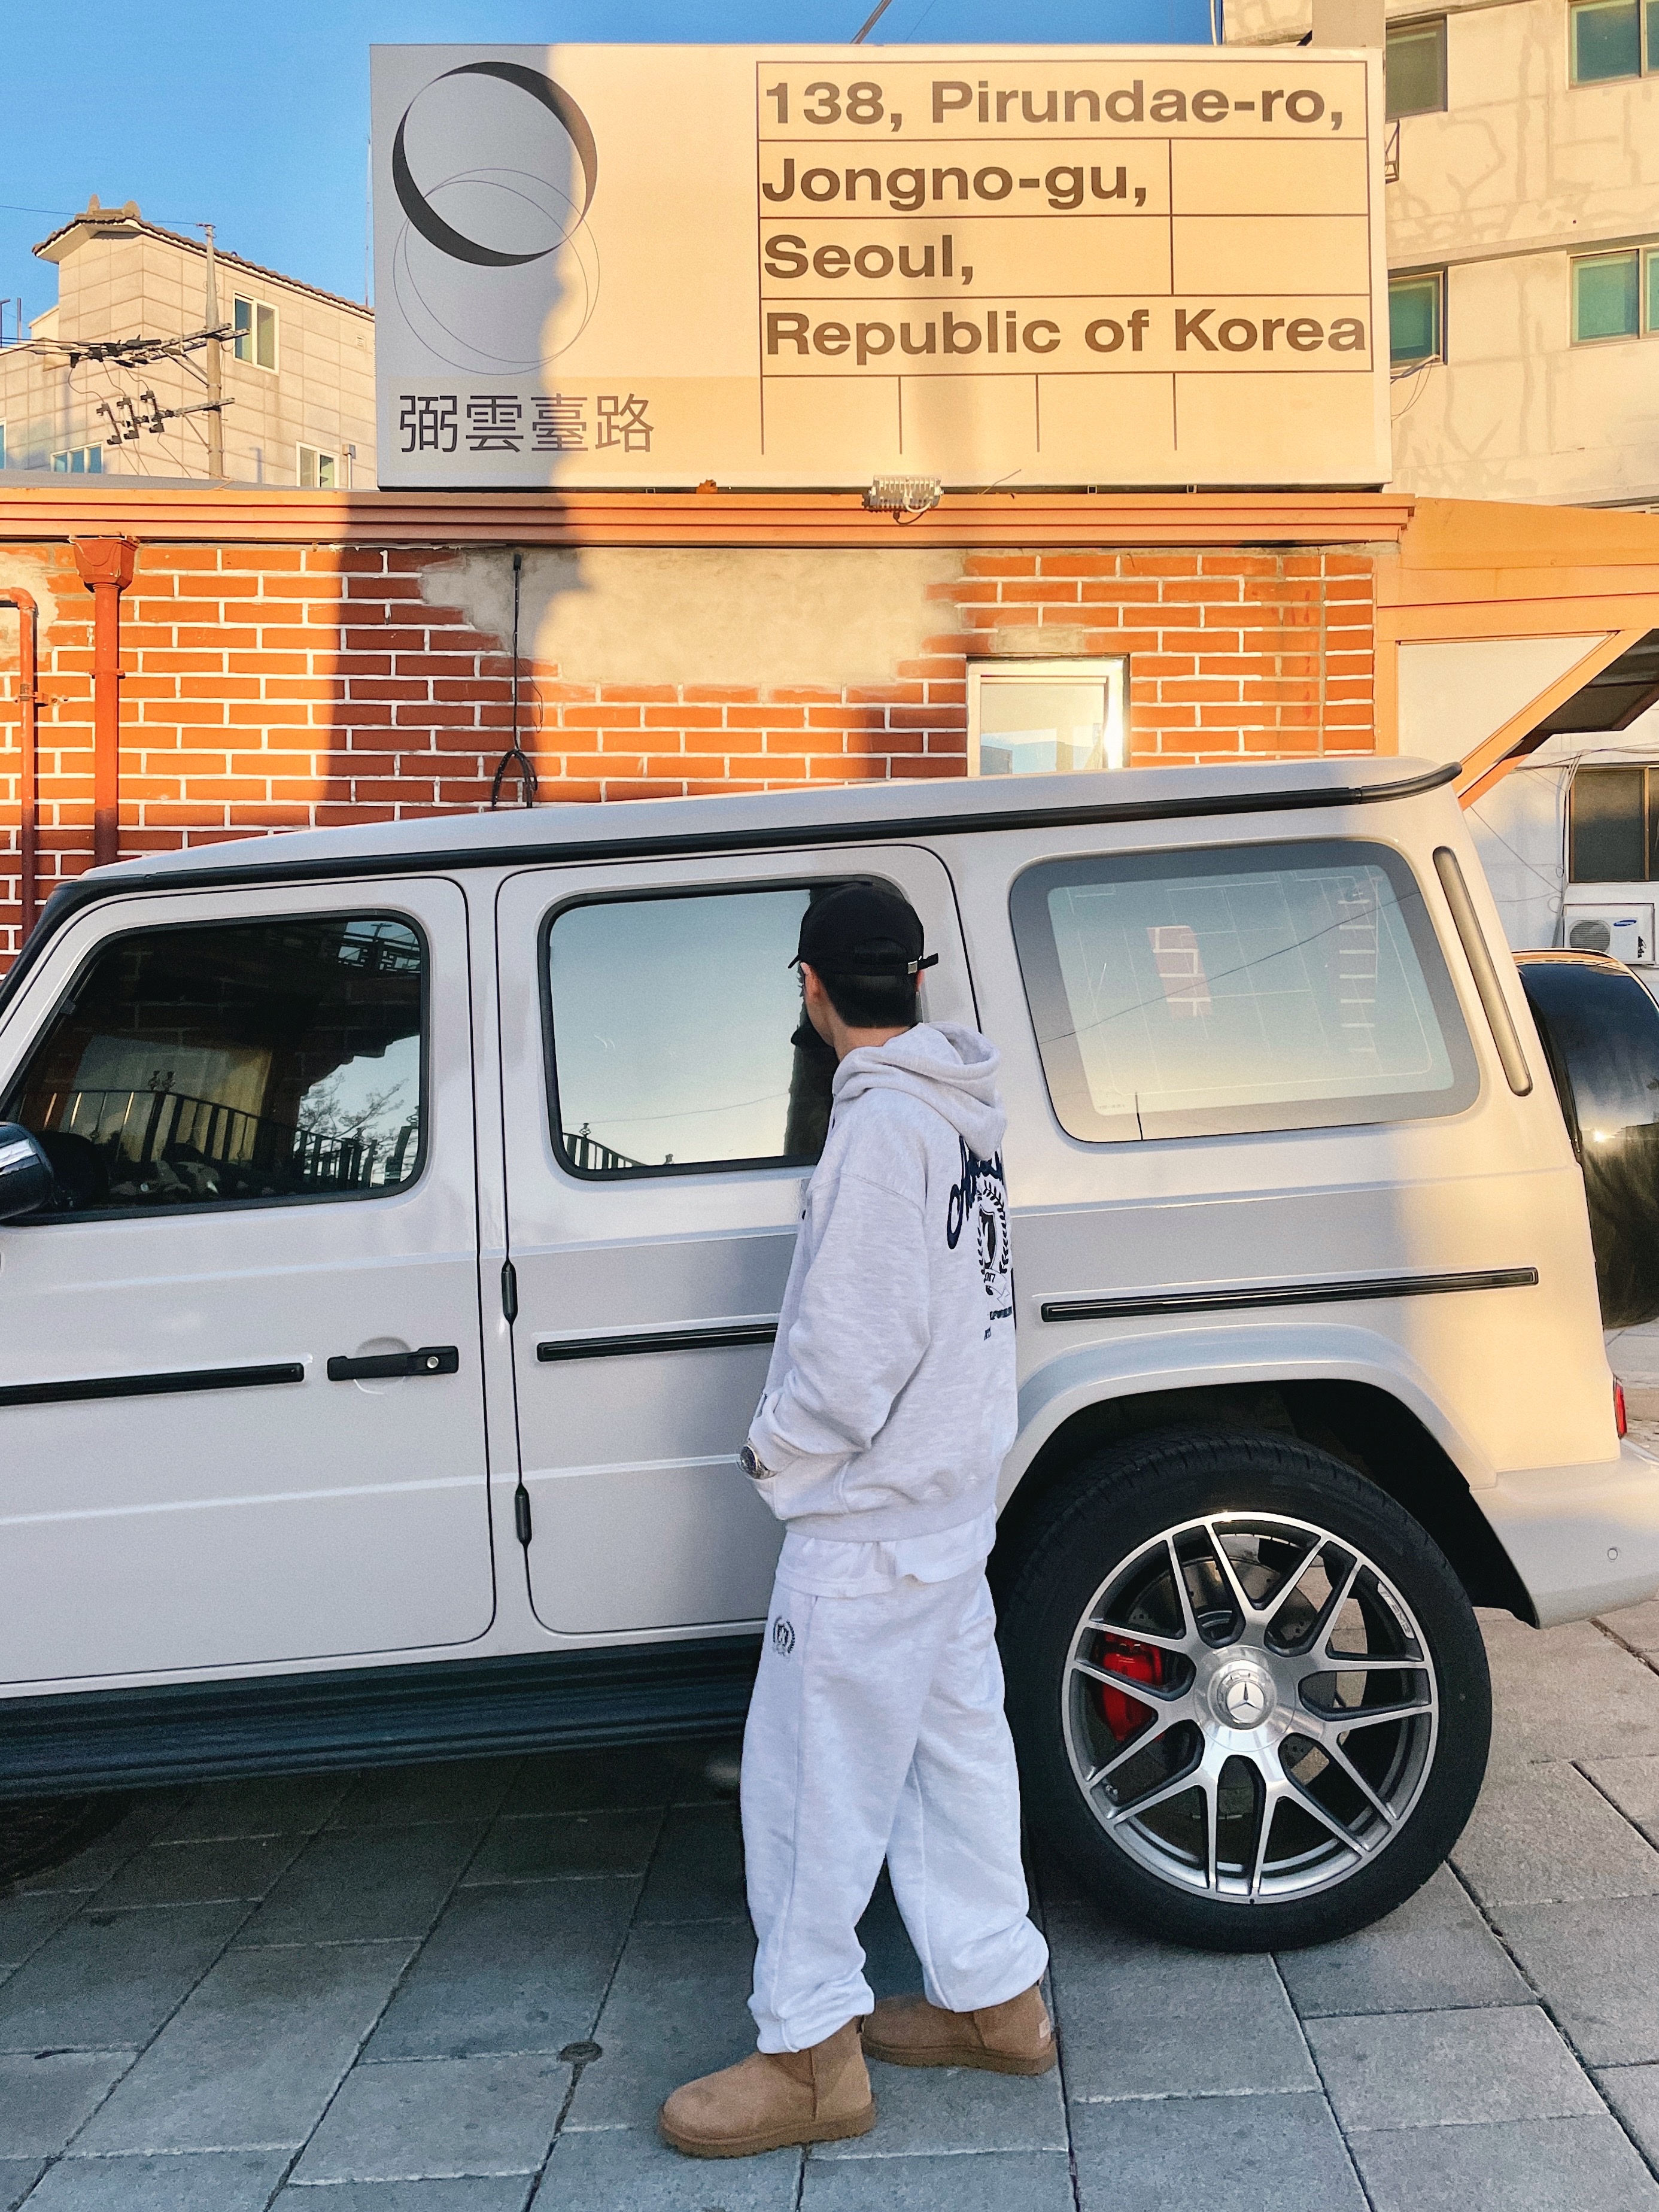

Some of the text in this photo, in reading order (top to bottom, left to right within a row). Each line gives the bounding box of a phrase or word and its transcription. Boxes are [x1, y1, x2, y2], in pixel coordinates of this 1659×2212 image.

[766, 80, 1343, 132] 138, Pirundae-ro,
[762, 158, 1147, 211] Jongno-gu,
[764, 234, 974, 285] Seoul,
[767, 308, 1367, 366] Republic of Korea
[399, 393, 655, 453] 弼雲臺路
